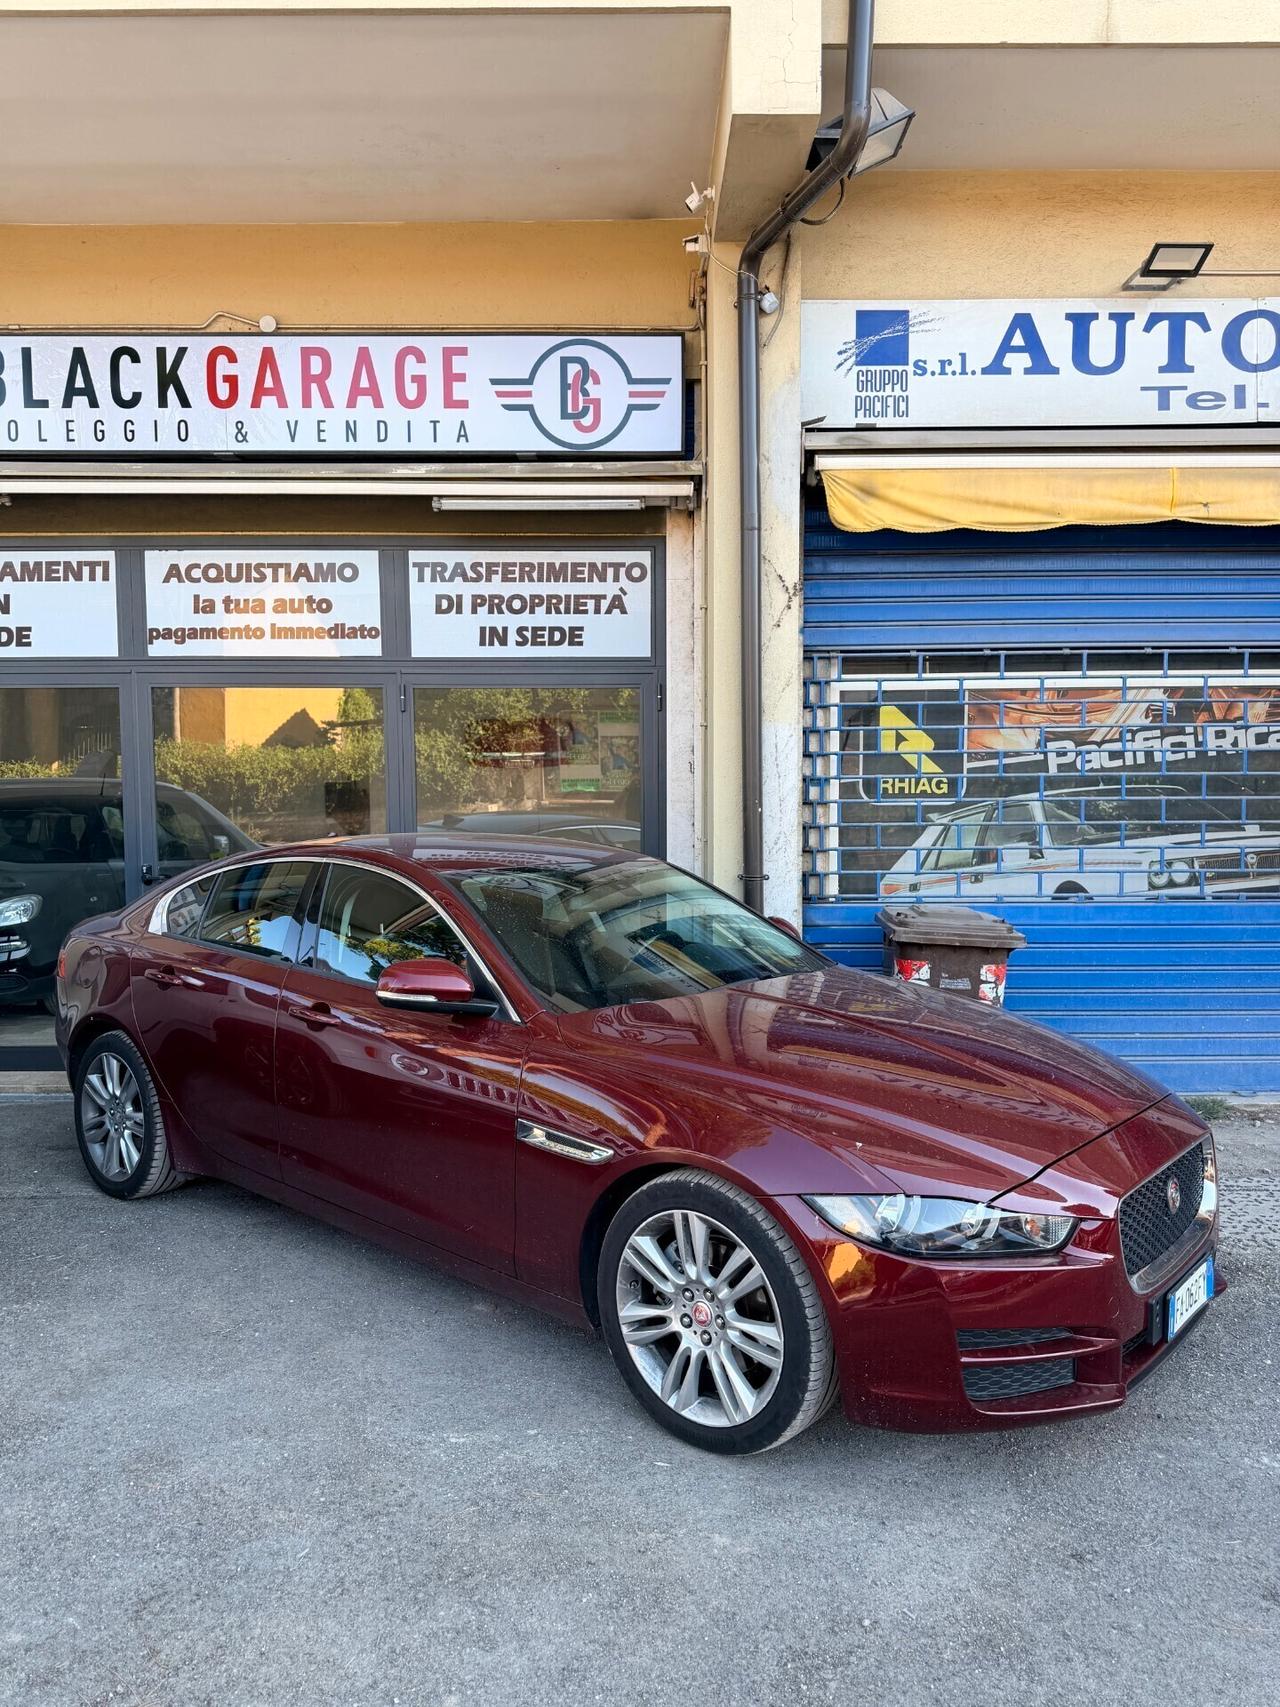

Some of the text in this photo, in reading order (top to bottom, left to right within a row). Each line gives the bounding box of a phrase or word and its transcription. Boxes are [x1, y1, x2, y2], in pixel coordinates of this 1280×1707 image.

[912, 309, 1280, 376] s.r.l. AUTO
[0, 345, 470, 409] LACKGARAGE
[856, 369, 908, 393] GRUPPO
[854, 394, 909, 418] PACIFICI
[235, 420, 249, 443] &
[286, 419, 470, 443] VENDITA
[0, 560, 110, 582] AMENTI
[162, 562, 360, 583] ACQUISTIAMO
[412, 561, 648, 583] TRASFERIMENTO
[193, 594, 333, 614] la tua auto
[435, 586, 628, 615] DI PROPRIETÀ
[148, 624, 265, 645] pagamento
[479, 625, 585, 647] IN SEDE
[1046, 725, 1197, 774] Pacifici
[880, 777, 949, 795] RHIAG
